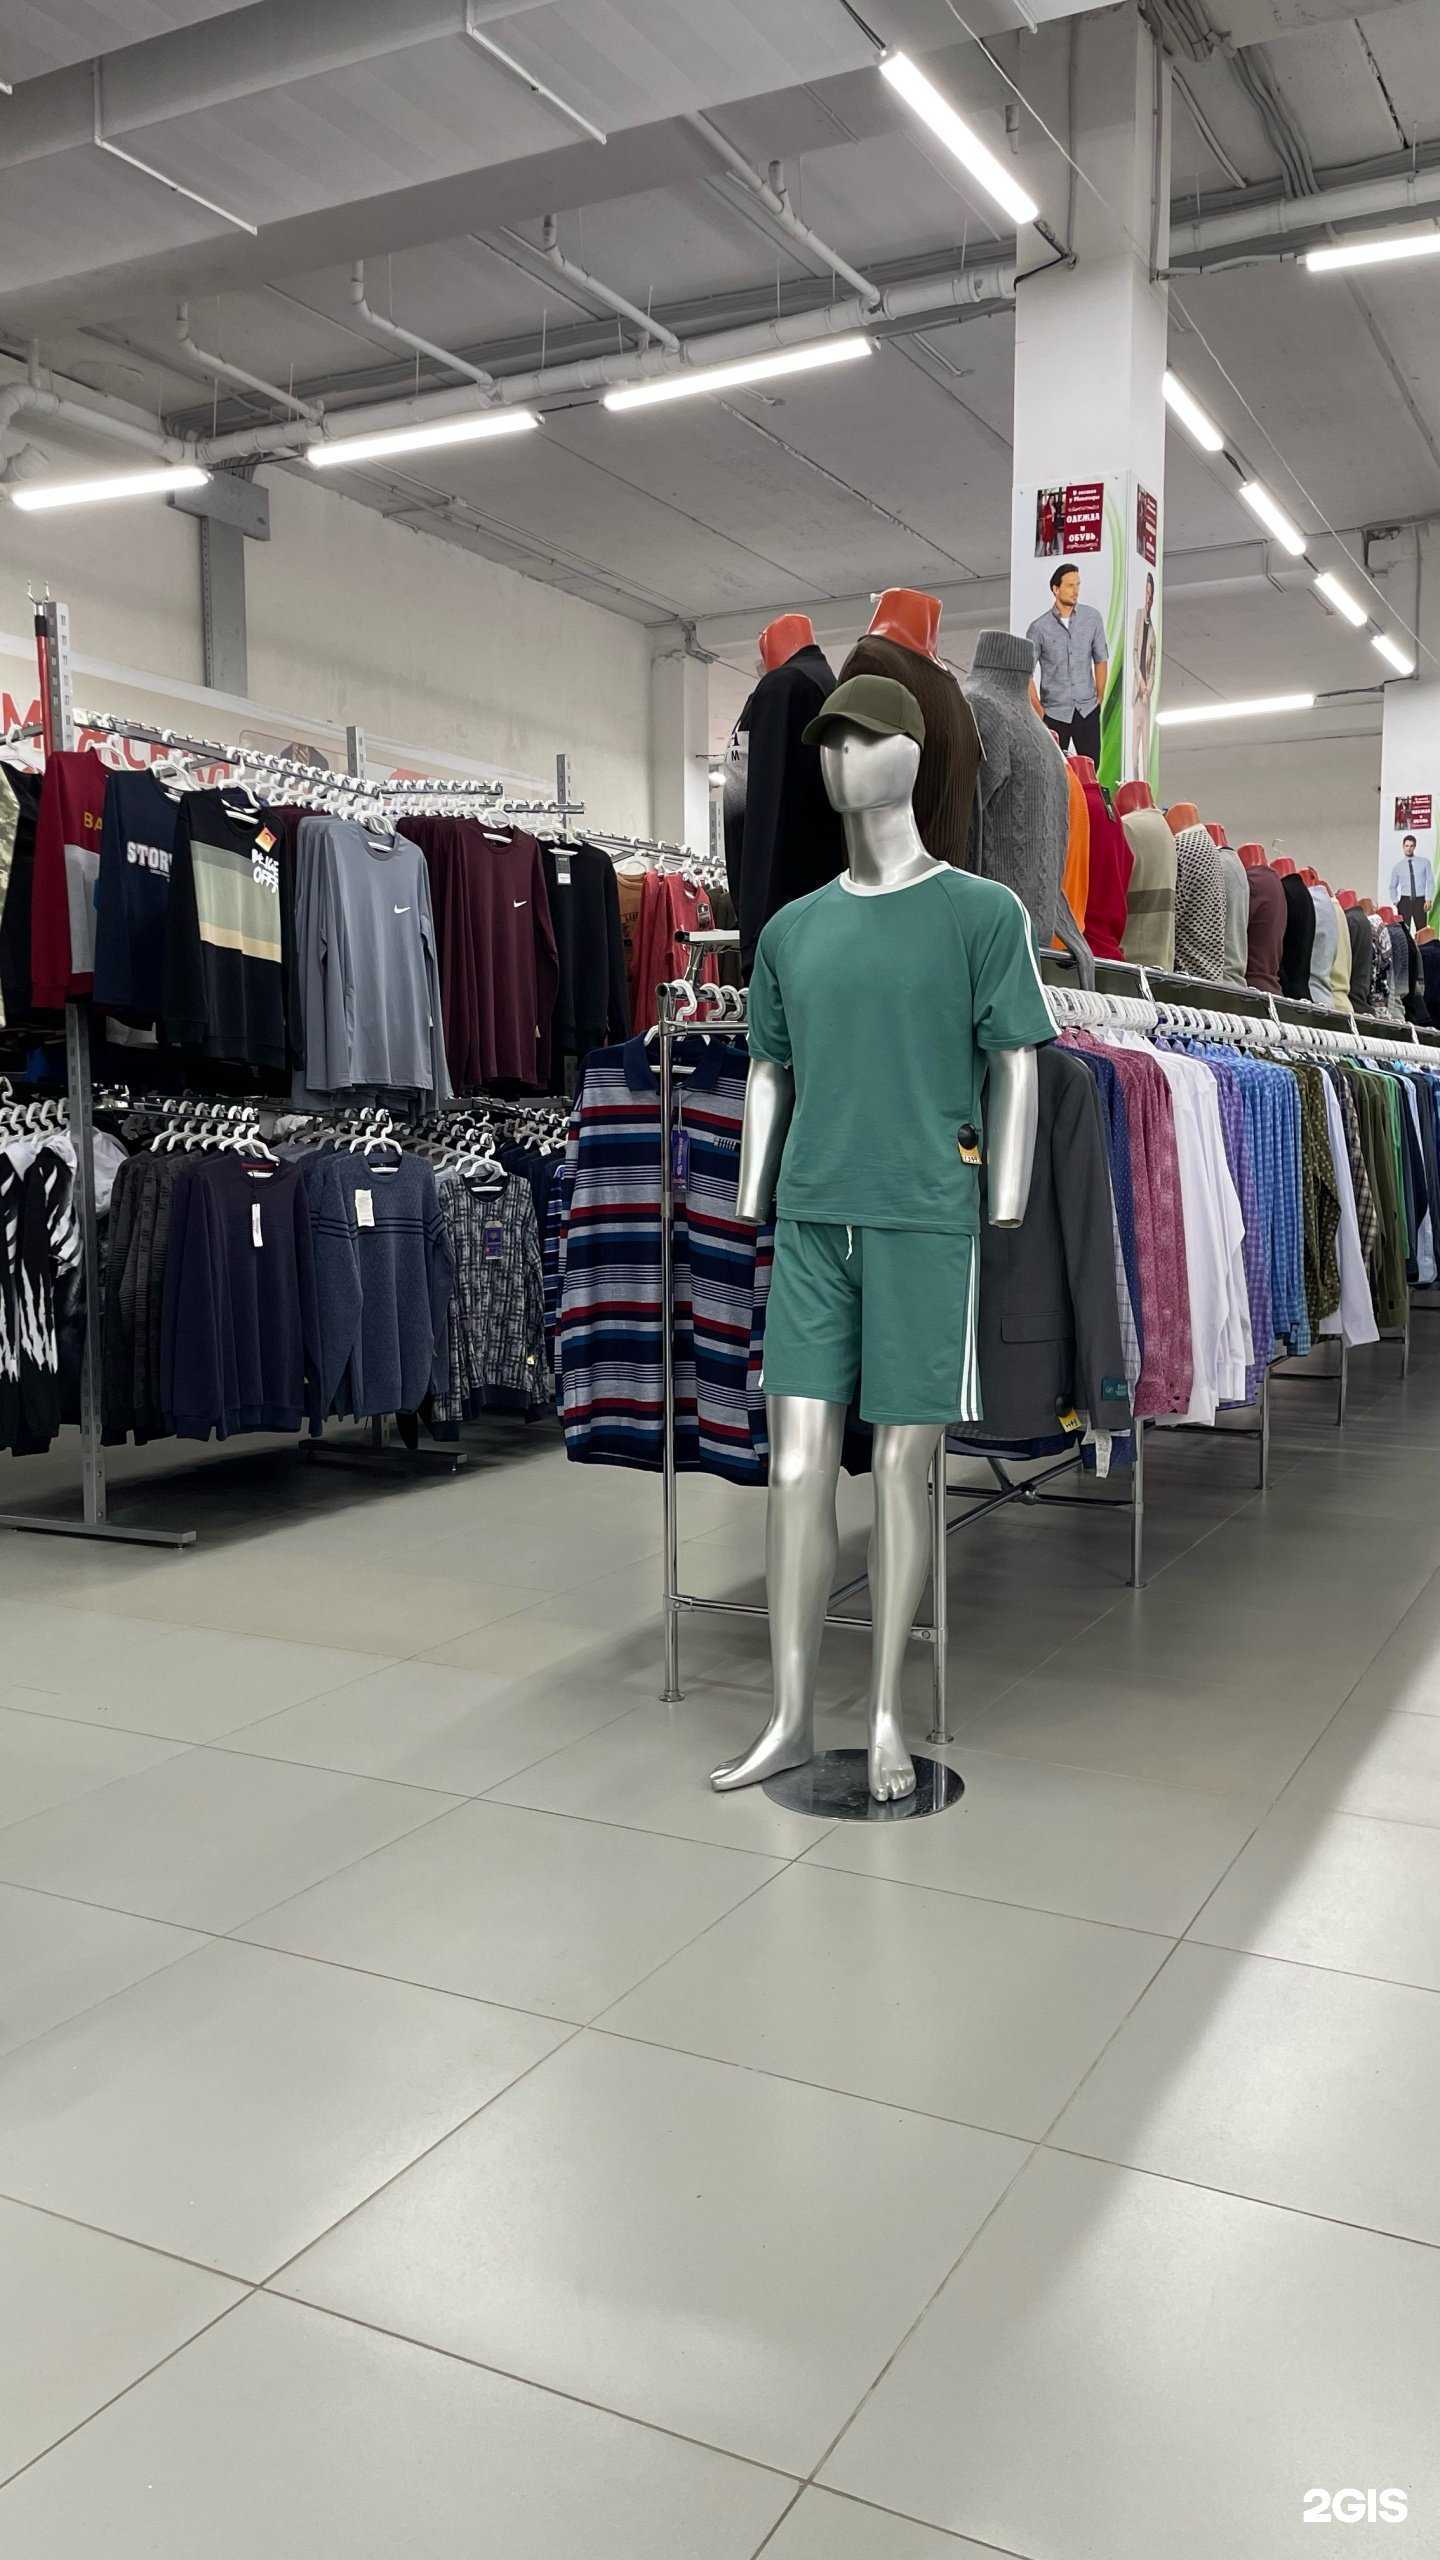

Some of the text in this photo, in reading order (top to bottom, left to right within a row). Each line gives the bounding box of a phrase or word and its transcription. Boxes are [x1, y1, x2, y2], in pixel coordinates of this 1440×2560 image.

[1066, 512, 1100, 523] ОДЕЖДА
[1068, 532, 1096, 542] ОБУВЬ
[127, 841, 173, 873] STOR
